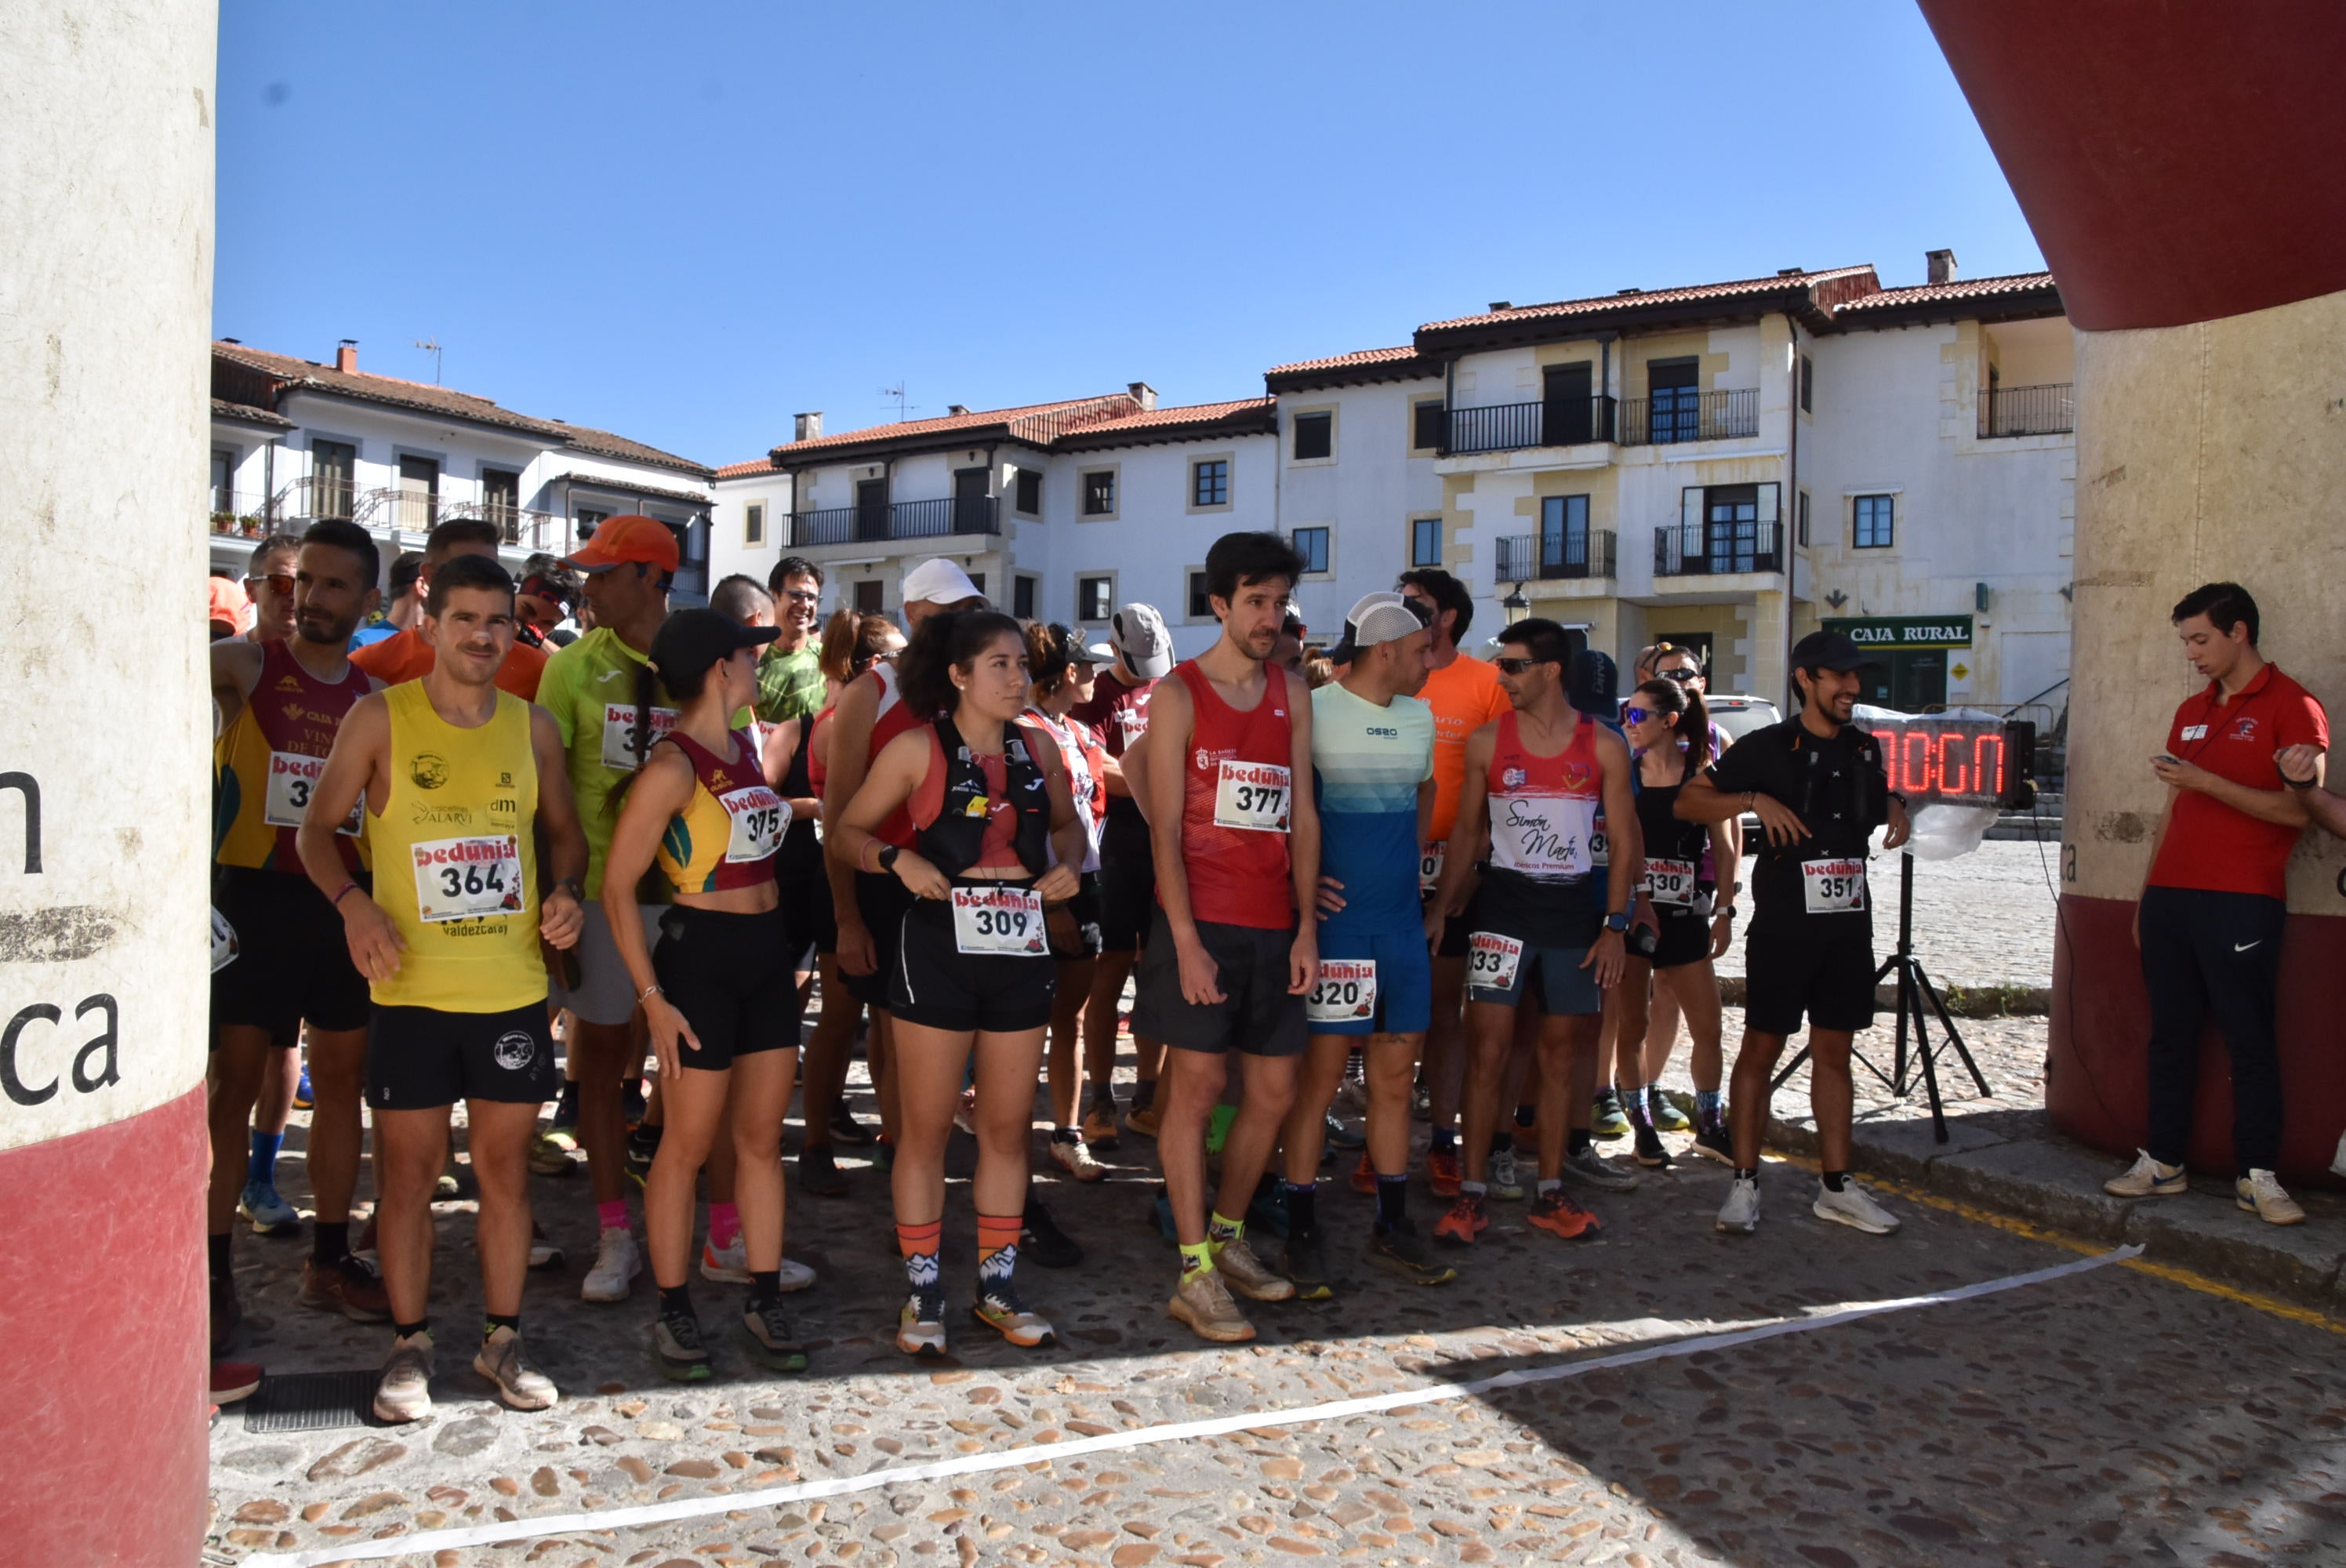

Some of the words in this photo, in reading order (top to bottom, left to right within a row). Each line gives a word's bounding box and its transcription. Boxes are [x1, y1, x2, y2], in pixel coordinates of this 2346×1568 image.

[1850, 628, 1895, 641] CAJA
[1904, 626, 1968, 641] RURAL
[307, 711, 332, 724] CAJA
[304, 729, 334, 745] VIN
[288, 741, 307, 753] DE
[314, 746, 330, 759] TO
[490, 800, 516, 812] dm
[1236, 786, 1282, 814] 377
[746, 808, 779, 841] 375
[1505, 800, 1551, 831] Simón
[417, 840, 516, 867] bedunia
[1644, 861, 1692, 875] dunia
[1804, 862, 1862, 876] bedunia
[441, 863, 504, 898] 364
[1821, 877, 1853, 898] 351
[954, 892, 1040, 910] bedunia
[975, 910, 1027, 937] 309
[1473, 935, 1519, 955] dunia
[1319, 964, 1373, 978] dunia
[1309, 982, 1359, 1005] 320
